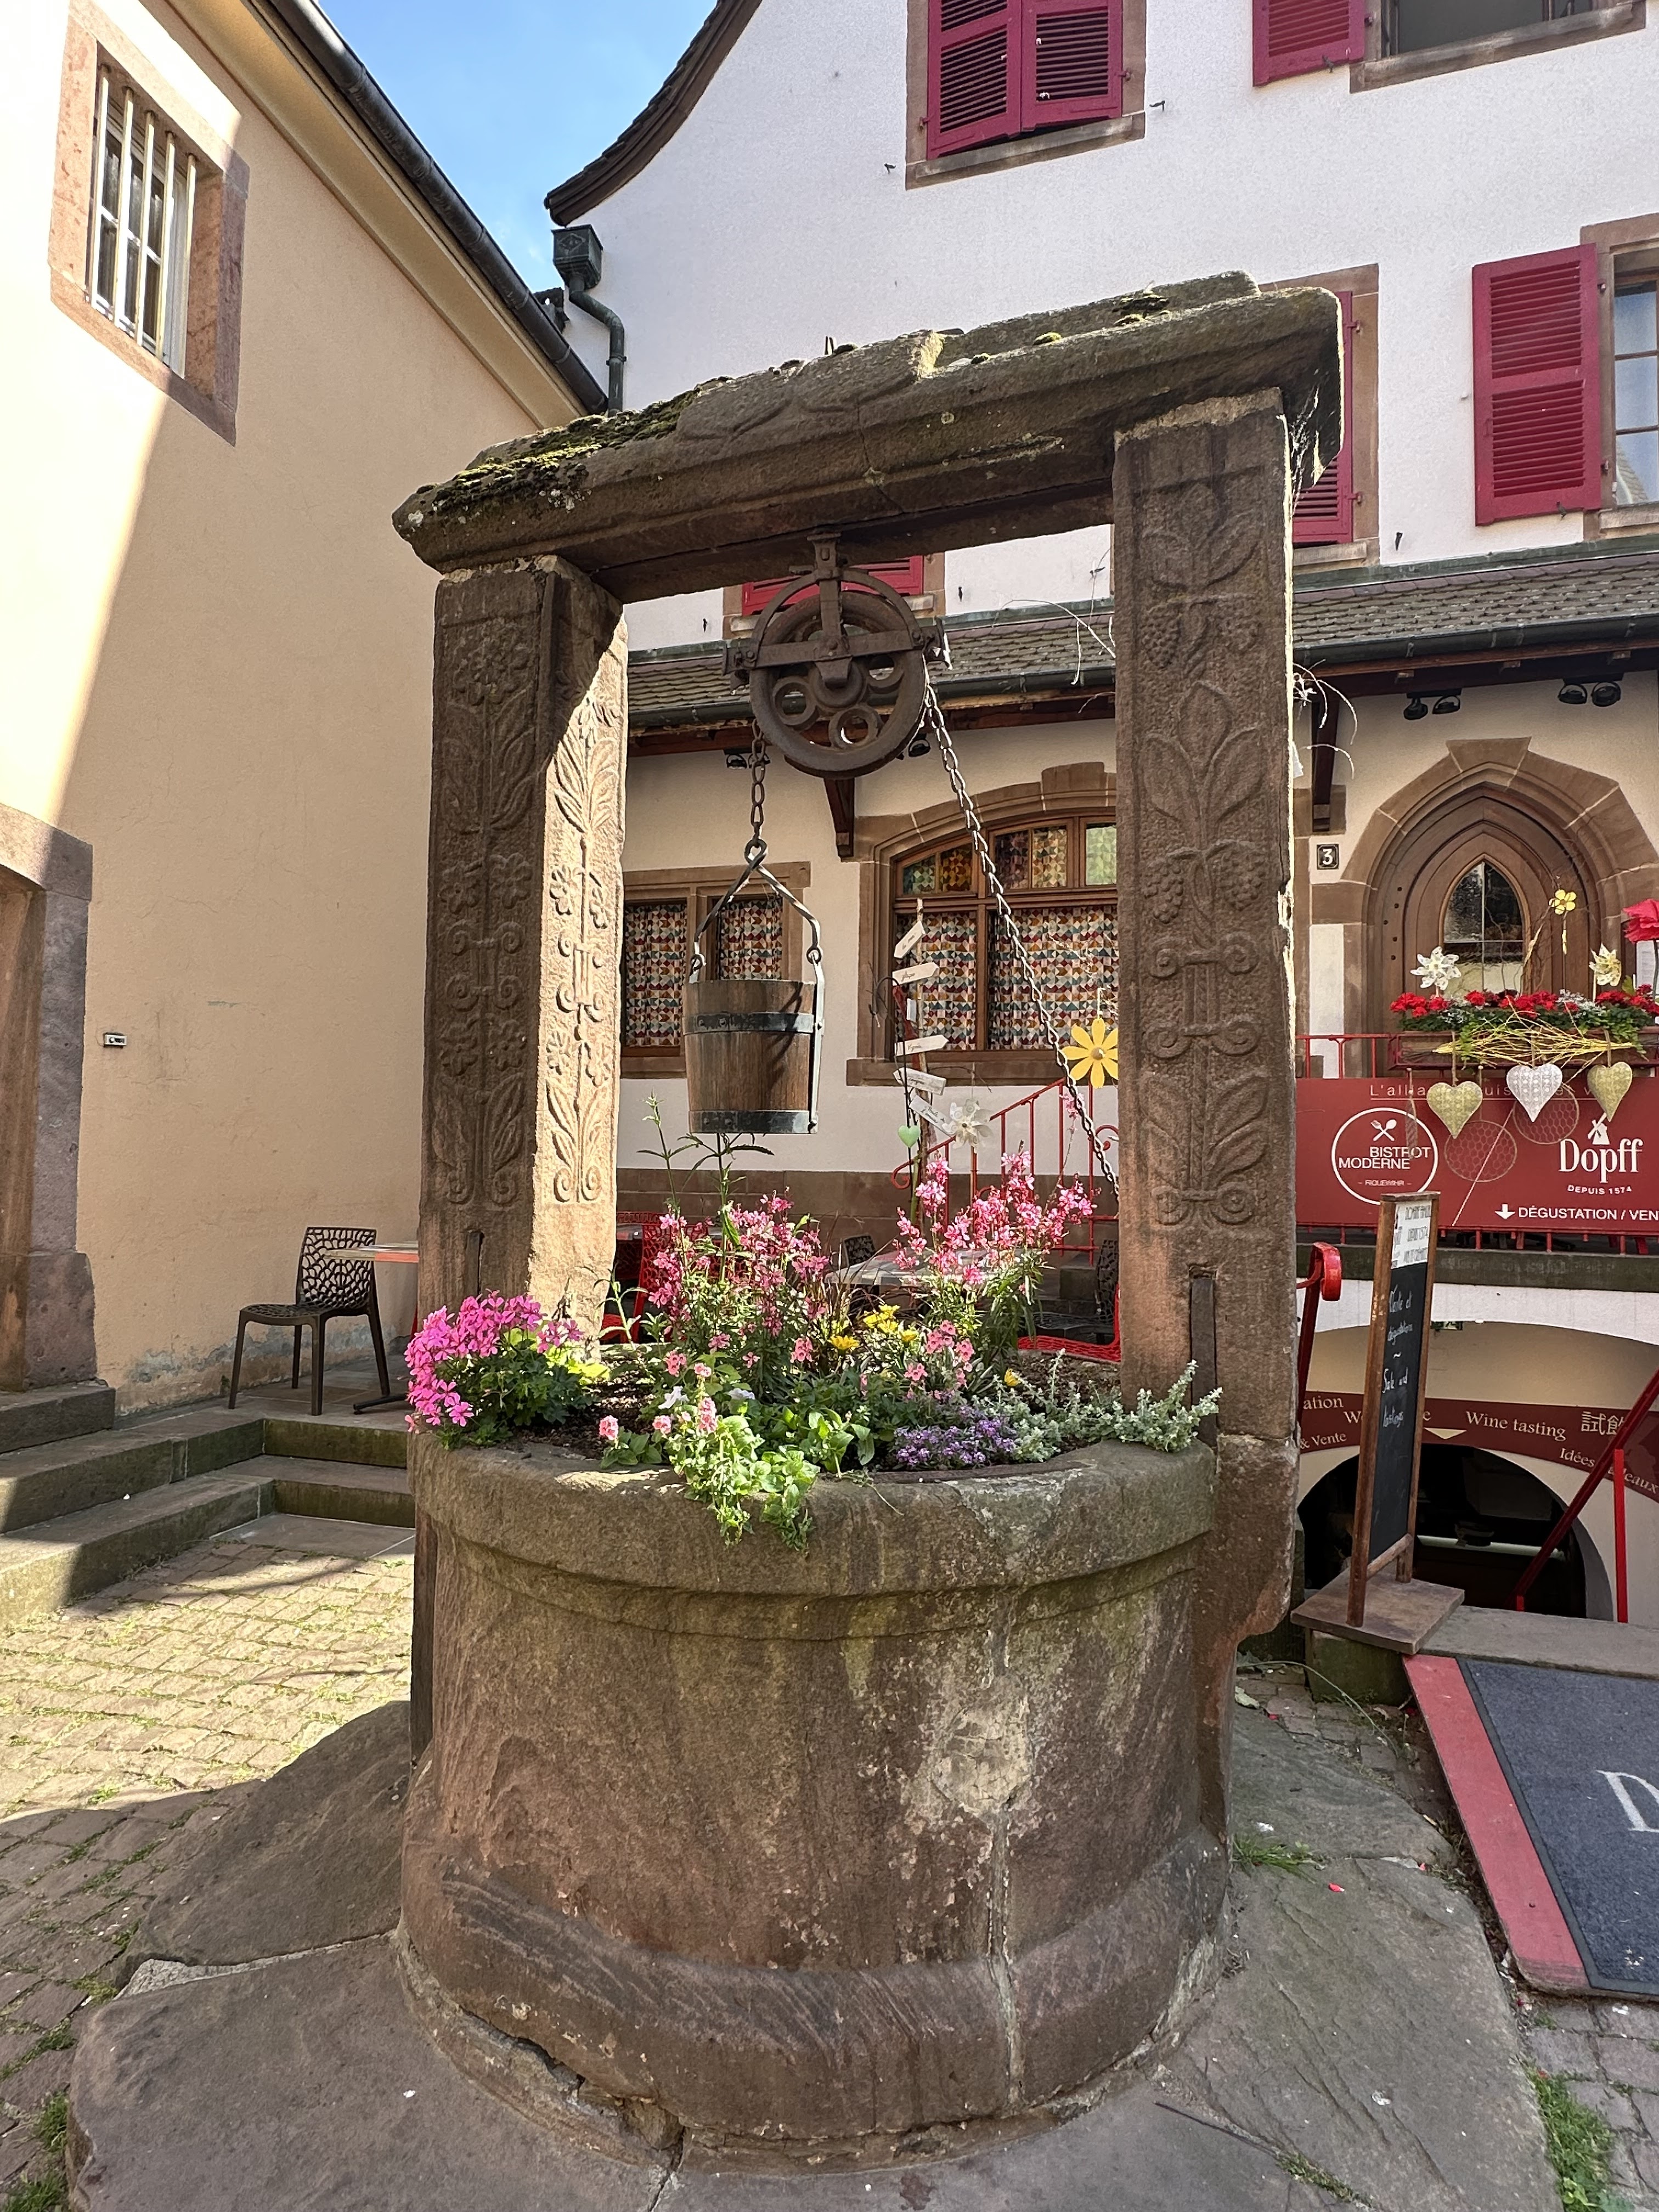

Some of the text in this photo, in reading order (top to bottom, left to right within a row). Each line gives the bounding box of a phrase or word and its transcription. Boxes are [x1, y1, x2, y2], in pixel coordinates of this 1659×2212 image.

[1322, 848, 1333, 865] 3
[1339, 1158, 1410, 1170] MODERNE
[1559, 1138, 1644, 1183] Dopff
[1567, 1184, 1605, 1195] DEPUIS
[1518, 1205, 1617, 1220] DÉGUSTATION
[1629, 1209, 1659, 1221] VEN
[1303, 1395, 1344, 1410] ation
[1466, 1411, 1567, 1442] Wine tasting
[1311, 1432, 1347, 1446] Vente
[1559, 1447, 1595, 1468] Idées
